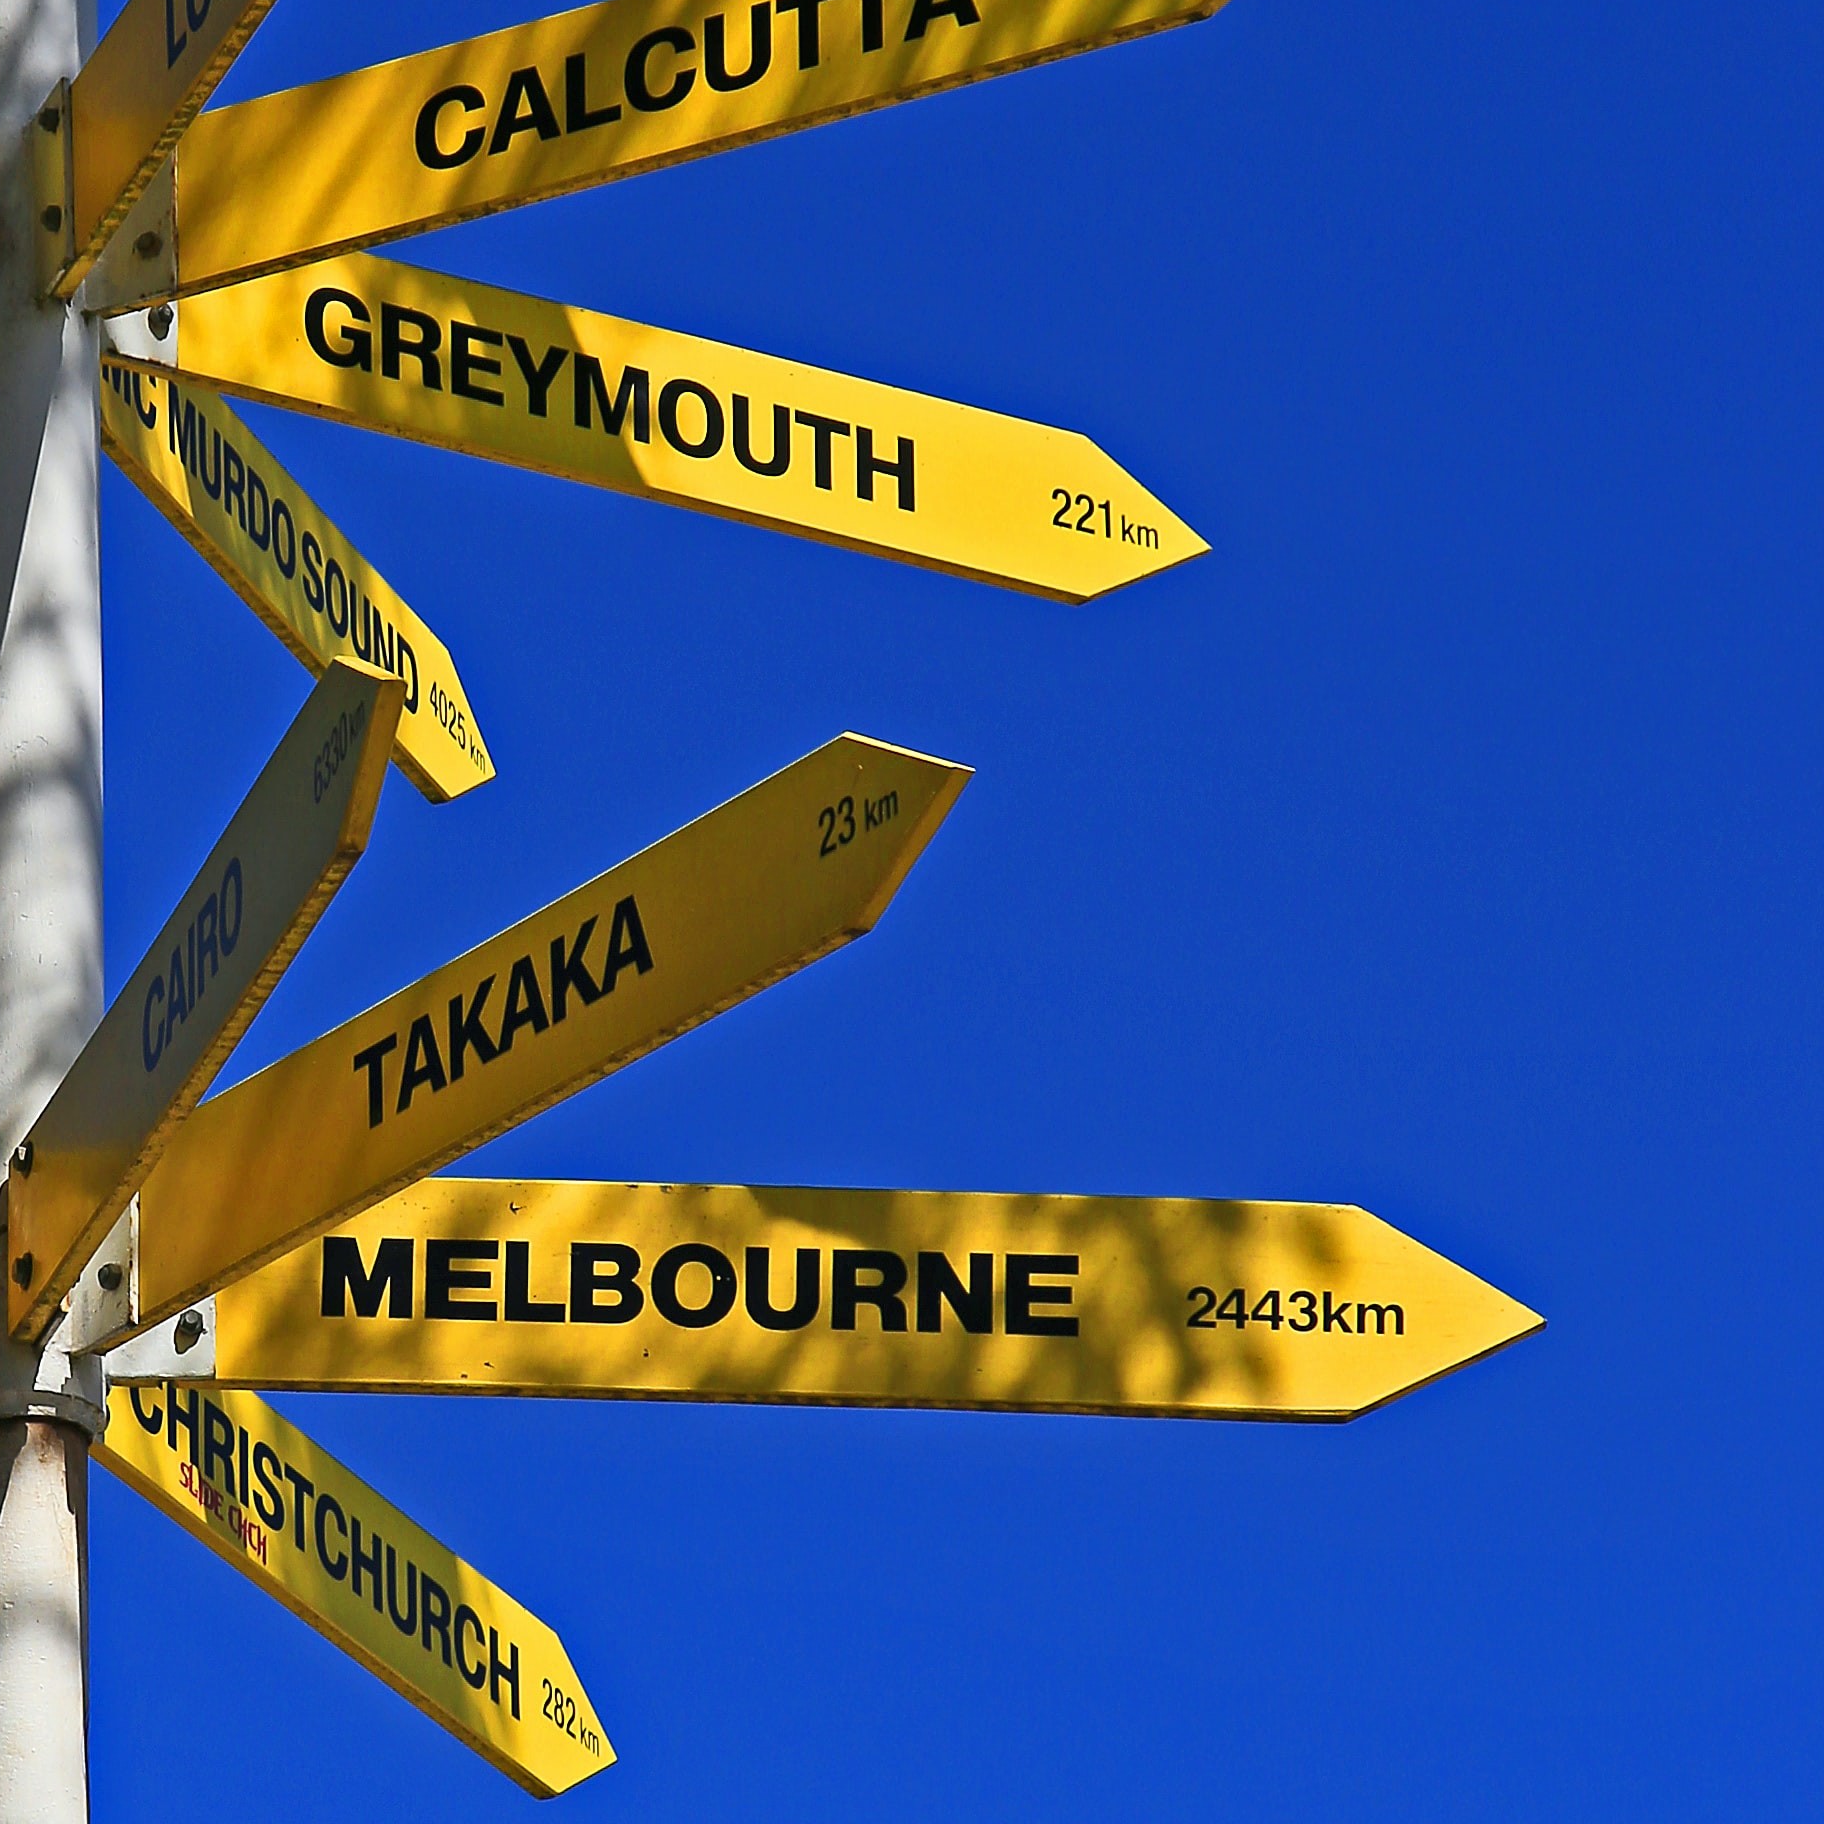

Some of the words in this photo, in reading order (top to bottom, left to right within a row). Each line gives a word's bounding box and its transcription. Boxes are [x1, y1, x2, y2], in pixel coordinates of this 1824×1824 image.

[304, 285, 917, 513] GREYMOUTH
[168, 379, 296, 580] MURDO
[301, 529, 419, 715] SOUND
[1051, 487, 1112, 539] 221
[429, 681, 466, 750] 4025
[469, 734, 486, 774] km
[818, 795, 857, 857] 23
[864, 787, 899, 832] km
[141, 857, 243, 1073] CAIRO
[353, 894, 653, 1130] TAKAKA
[321, 1236, 1080, 1338] MELBOURNE
[1186, 1285, 1406, 1337] 2443km
[129, 1384, 521, 1722] CHRISTCHURCH
[541, 1678, 576, 1740] 282
[579, 1716, 601, 1758] km
